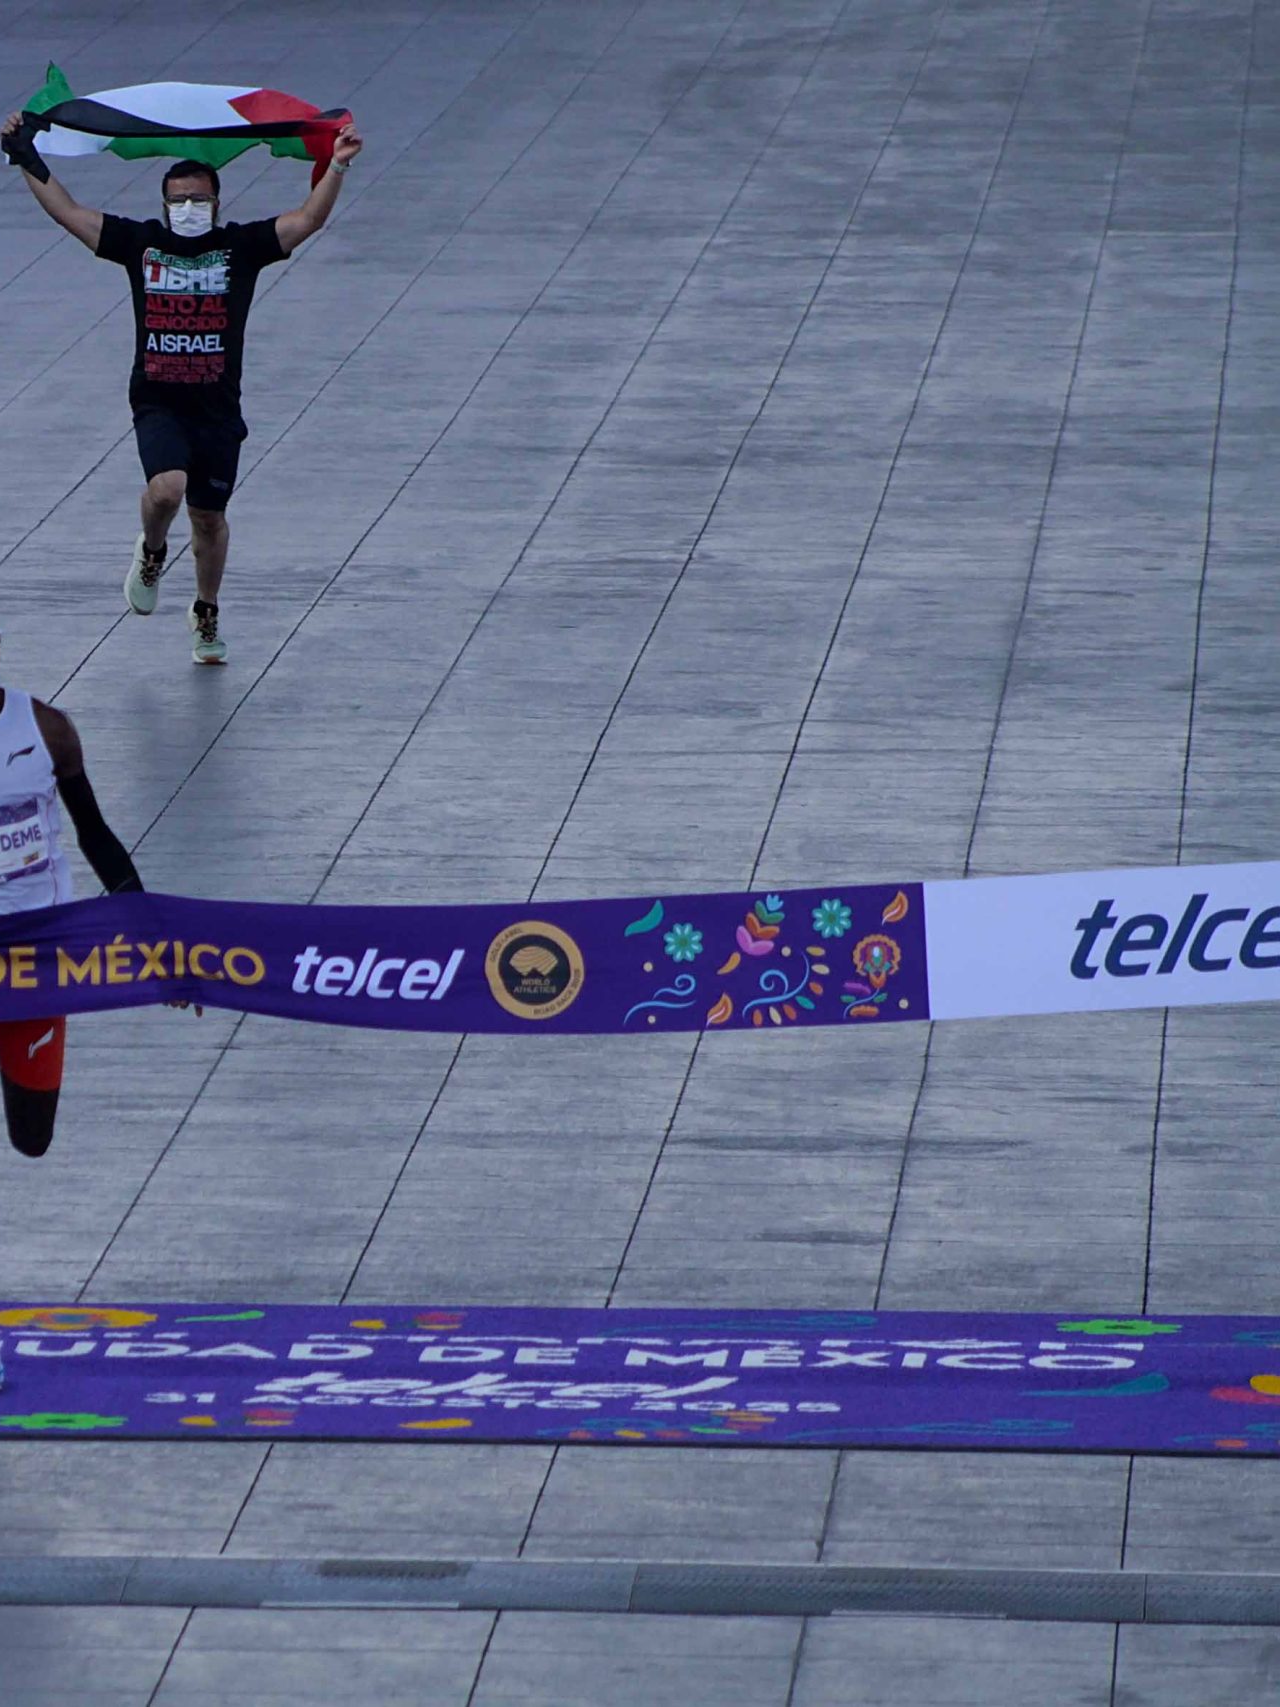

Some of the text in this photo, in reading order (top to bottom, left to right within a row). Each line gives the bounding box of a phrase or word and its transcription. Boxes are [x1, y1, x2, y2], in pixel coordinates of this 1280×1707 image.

[145, 294, 227, 314] ALTO AL
[145, 314, 227, 331] GENOCIDIO
[146, 333, 225, 352] A ISRAEL
[0, 823, 42, 852] DEME
[56, 933, 266, 988] MÉXICO
[291, 946, 466, 1000] telcel
[521, 978, 551, 986] WORLD
[418, 1345, 579, 1365] DE
[622, 1345, 1137, 1370] MÉXICO
[254, 1371, 740, 1399] telcel
[143, 1391, 217, 1404] 31
[242, 1393, 603, 1409] AGOSTO
